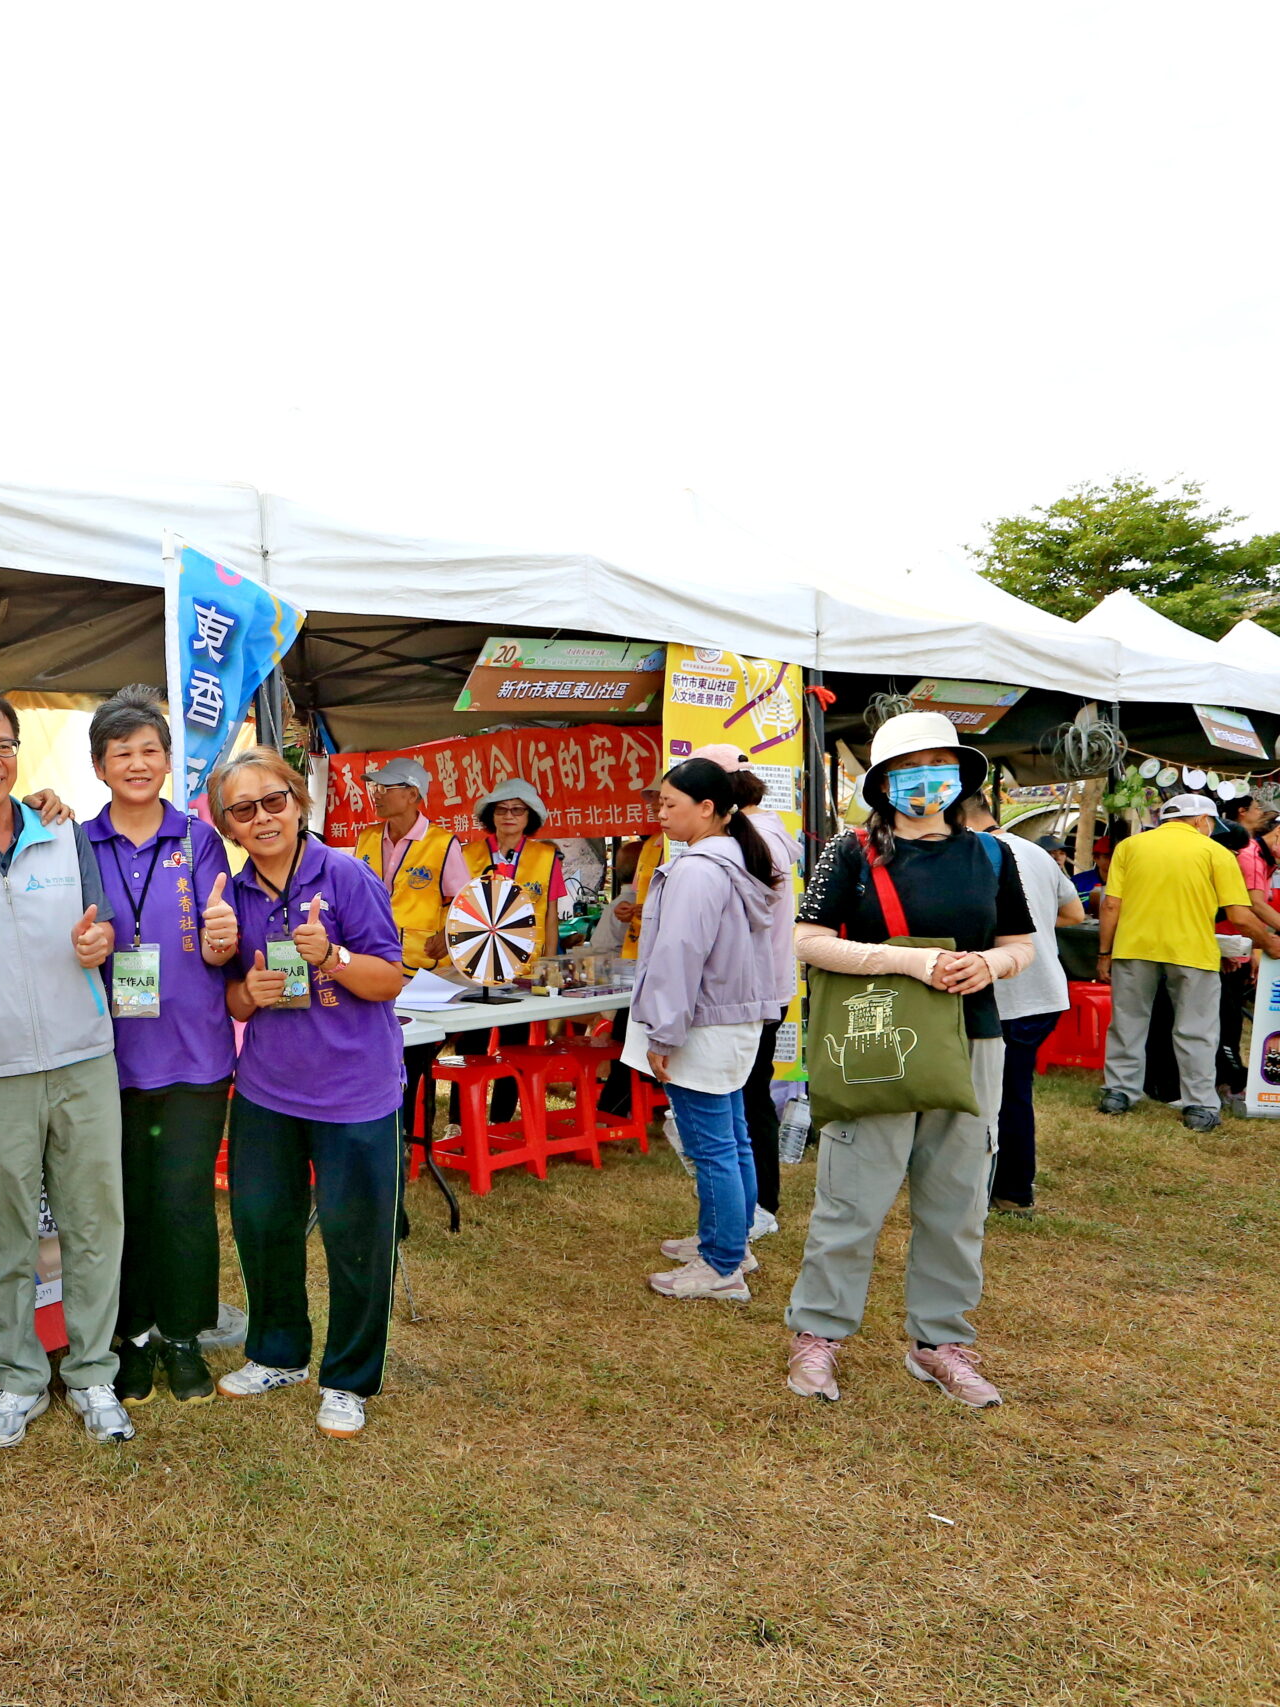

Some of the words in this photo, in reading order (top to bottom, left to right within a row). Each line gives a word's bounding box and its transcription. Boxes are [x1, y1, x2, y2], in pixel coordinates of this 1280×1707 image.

[493, 645, 517, 664] 20
[497, 680, 630, 700] 新竹市東區東山社區
[672, 673, 737, 693] 新竹市東山社區
[671, 689, 733, 709] 人文地產景簡介
[176, 876, 197, 952] 東香社區
[117, 976, 155, 987] 工作人員
